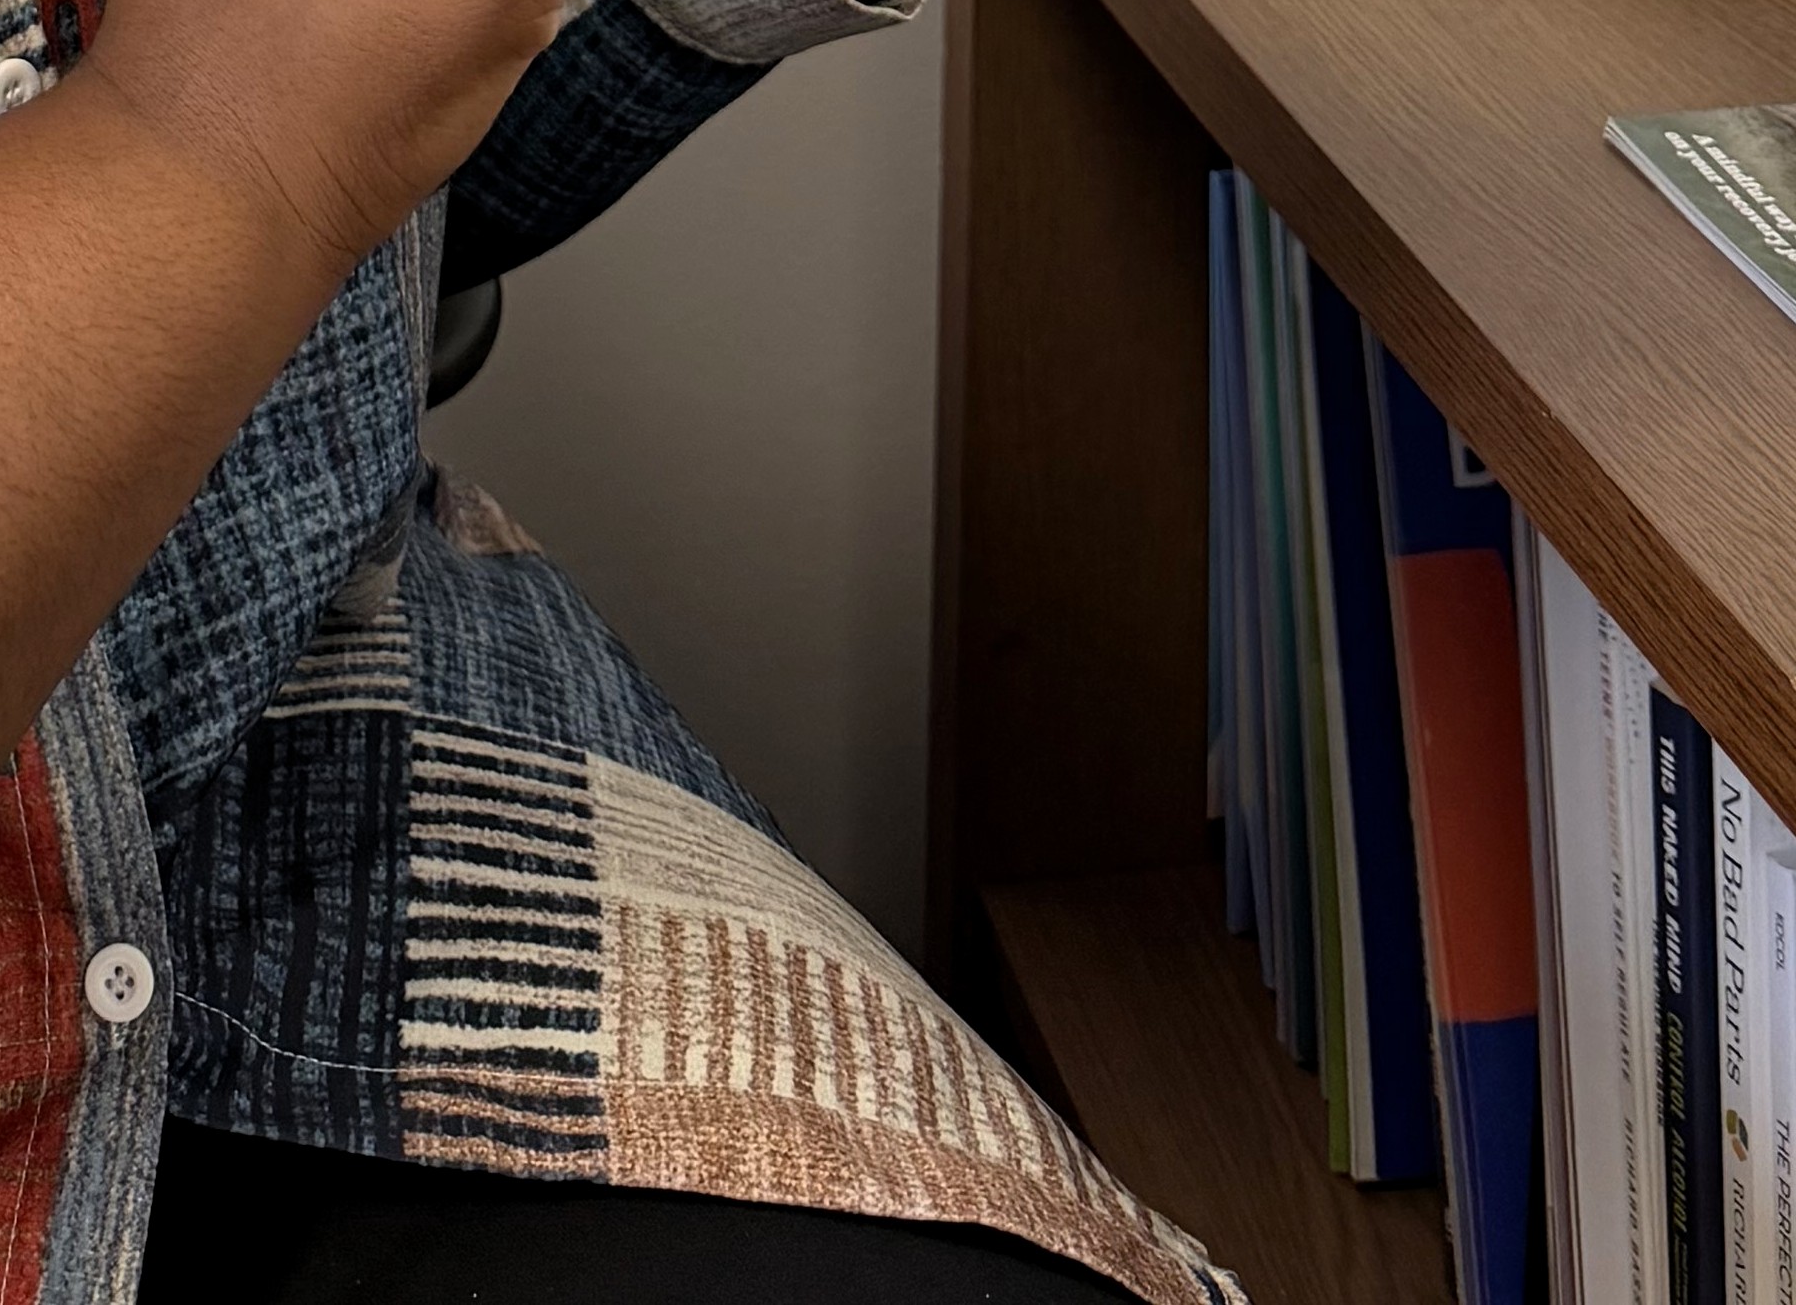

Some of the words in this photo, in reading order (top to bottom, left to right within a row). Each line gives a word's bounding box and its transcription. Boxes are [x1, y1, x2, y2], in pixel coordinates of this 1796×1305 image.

[1664, 132, 1691, 149] on
[1676, 150, 1725, 183] your
[1692, 134, 1717, 145] A
[1705, 147, 1775, 204] mindful
[1715, 185, 1791, 247] recovery
[1660, 736, 1676, 795] THIS
[1721, 777, 1742, 843] No
[1662, 805, 1680, 906] NAKED
[1722, 850, 1745, 952] Bad
[1665, 913, 1682, 994] MIND
[1723, 955, 1745, 1086] Parts
[1667, 1012, 1685, 1120] CONTROL
[1671, 1128, 1687, 1233] ALCOHOL
[1775, 1119, 1790, 1174] THE
